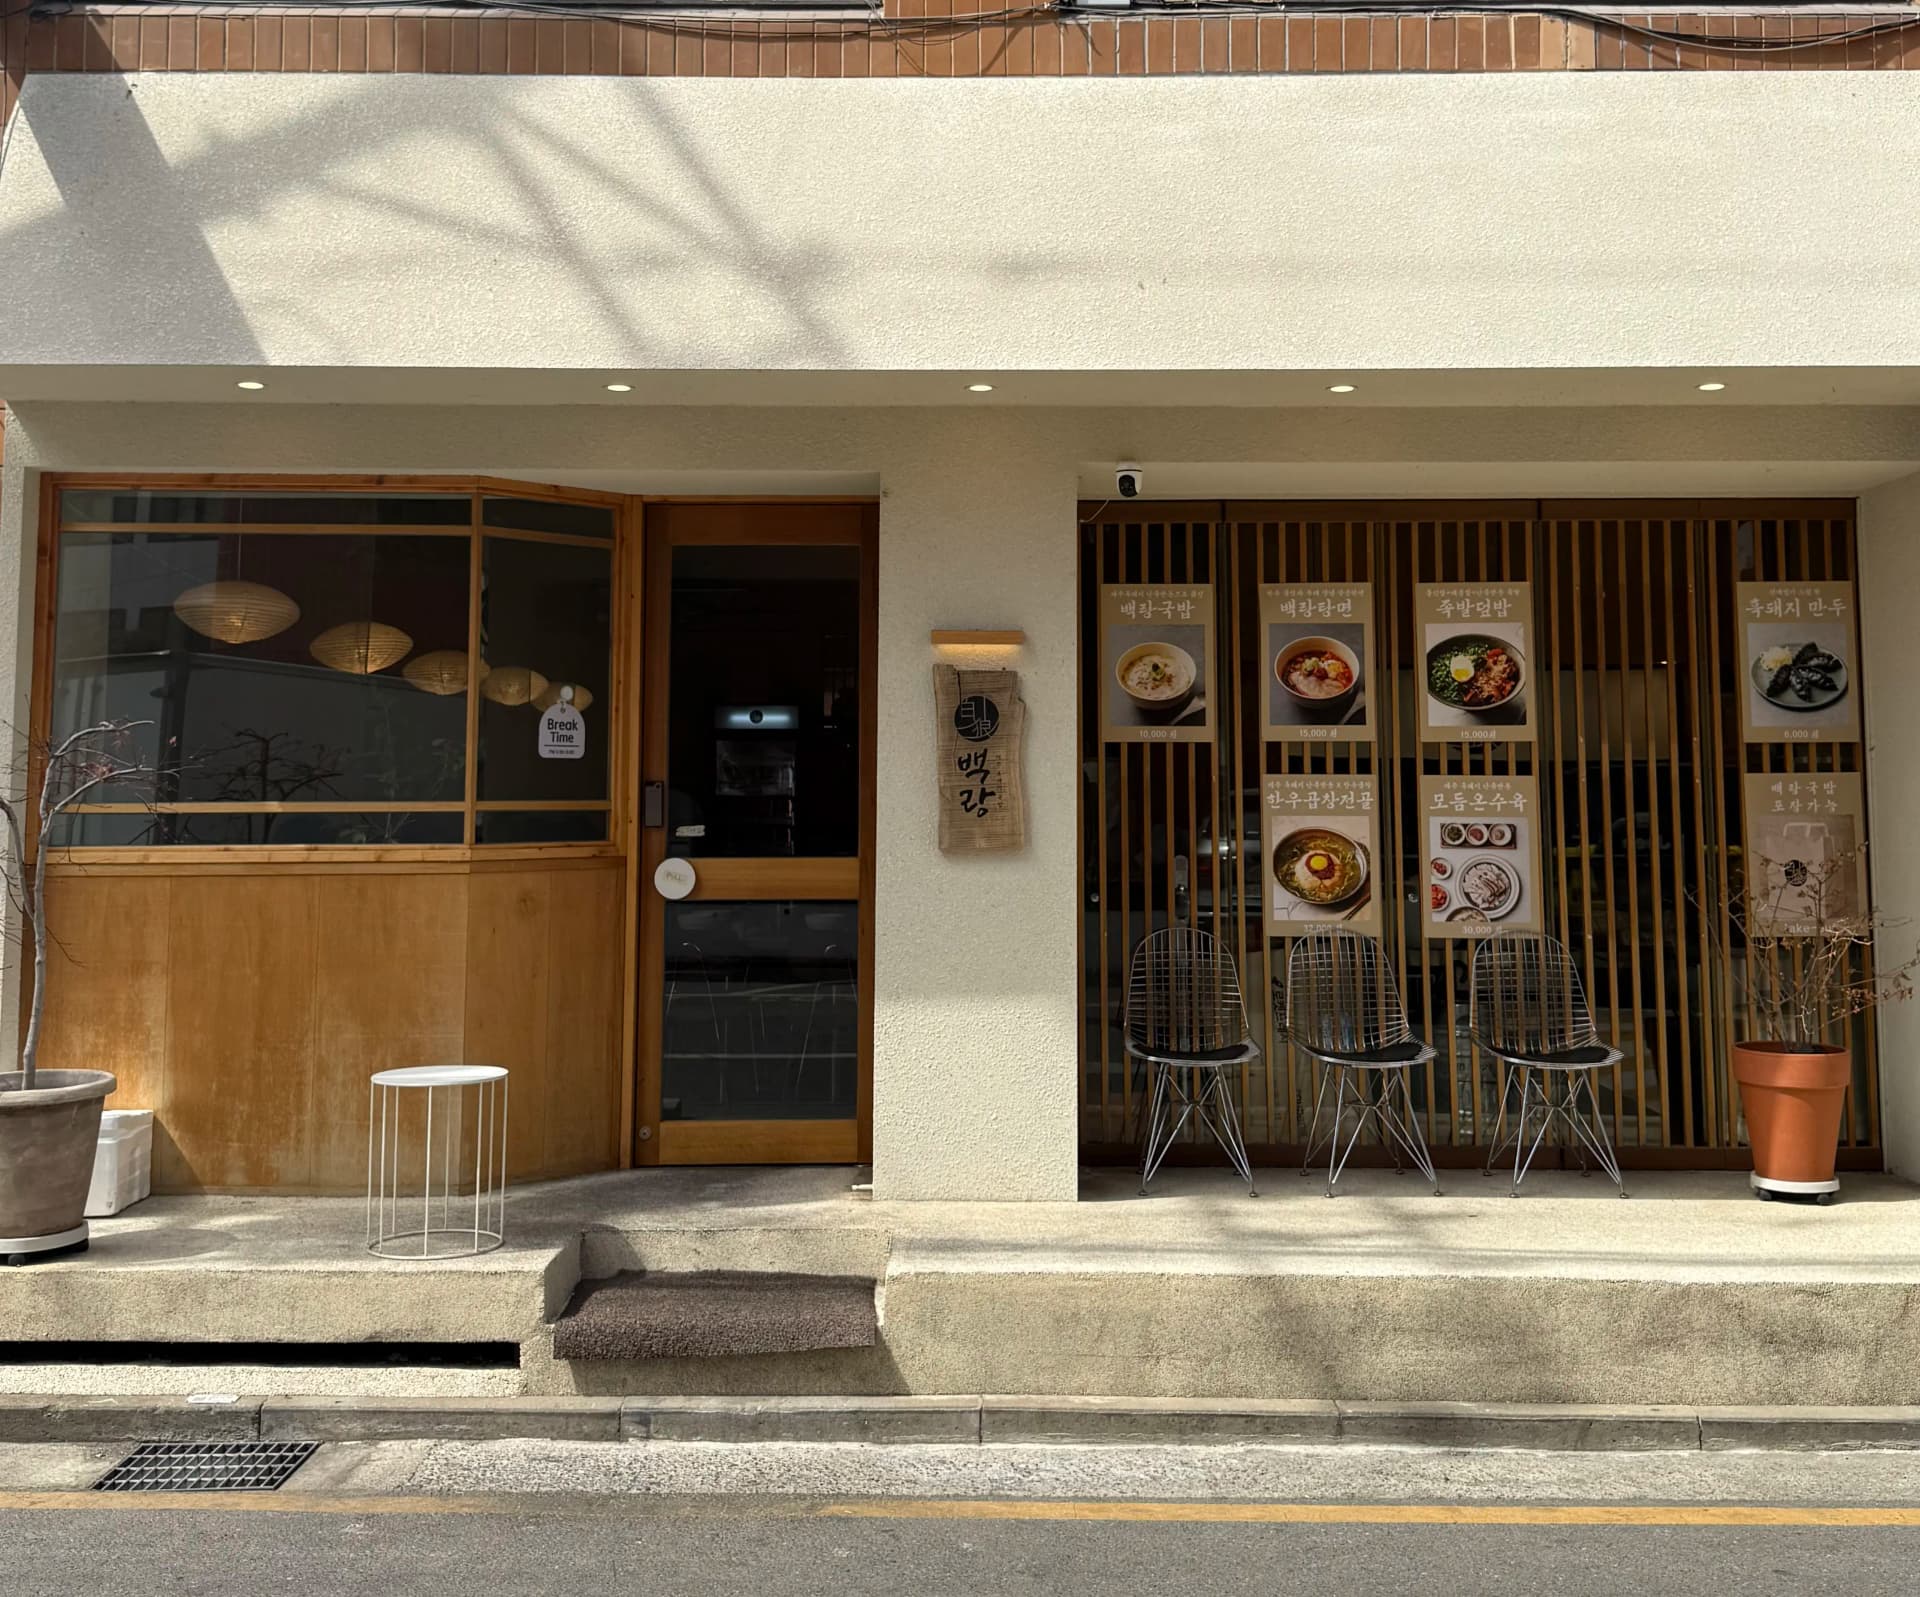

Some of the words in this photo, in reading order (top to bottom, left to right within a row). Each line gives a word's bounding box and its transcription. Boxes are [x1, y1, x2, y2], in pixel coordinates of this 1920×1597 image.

[1120, 599, 1196, 620] 백랑국밥
[1280, 598, 1352, 618] 백랑탕면
[1435, 598, 1512, 618] 족발덮밥
[1745, 597, 1800, 618] 흑돼지
[1808, 597, 1847, 617] 만두
[547, 718, 578, 731] Break
[1139, 729, 1167, 739] 10,000
[1299, 728, 1327, 738] 15,000
[550, 731, 574, 743] Time
[957, 748, 996, 818] 백랑
[1266, 791, 1374, 810] 한우곱창전골
[1429, 792, 1528, 813] 모듬온수육
